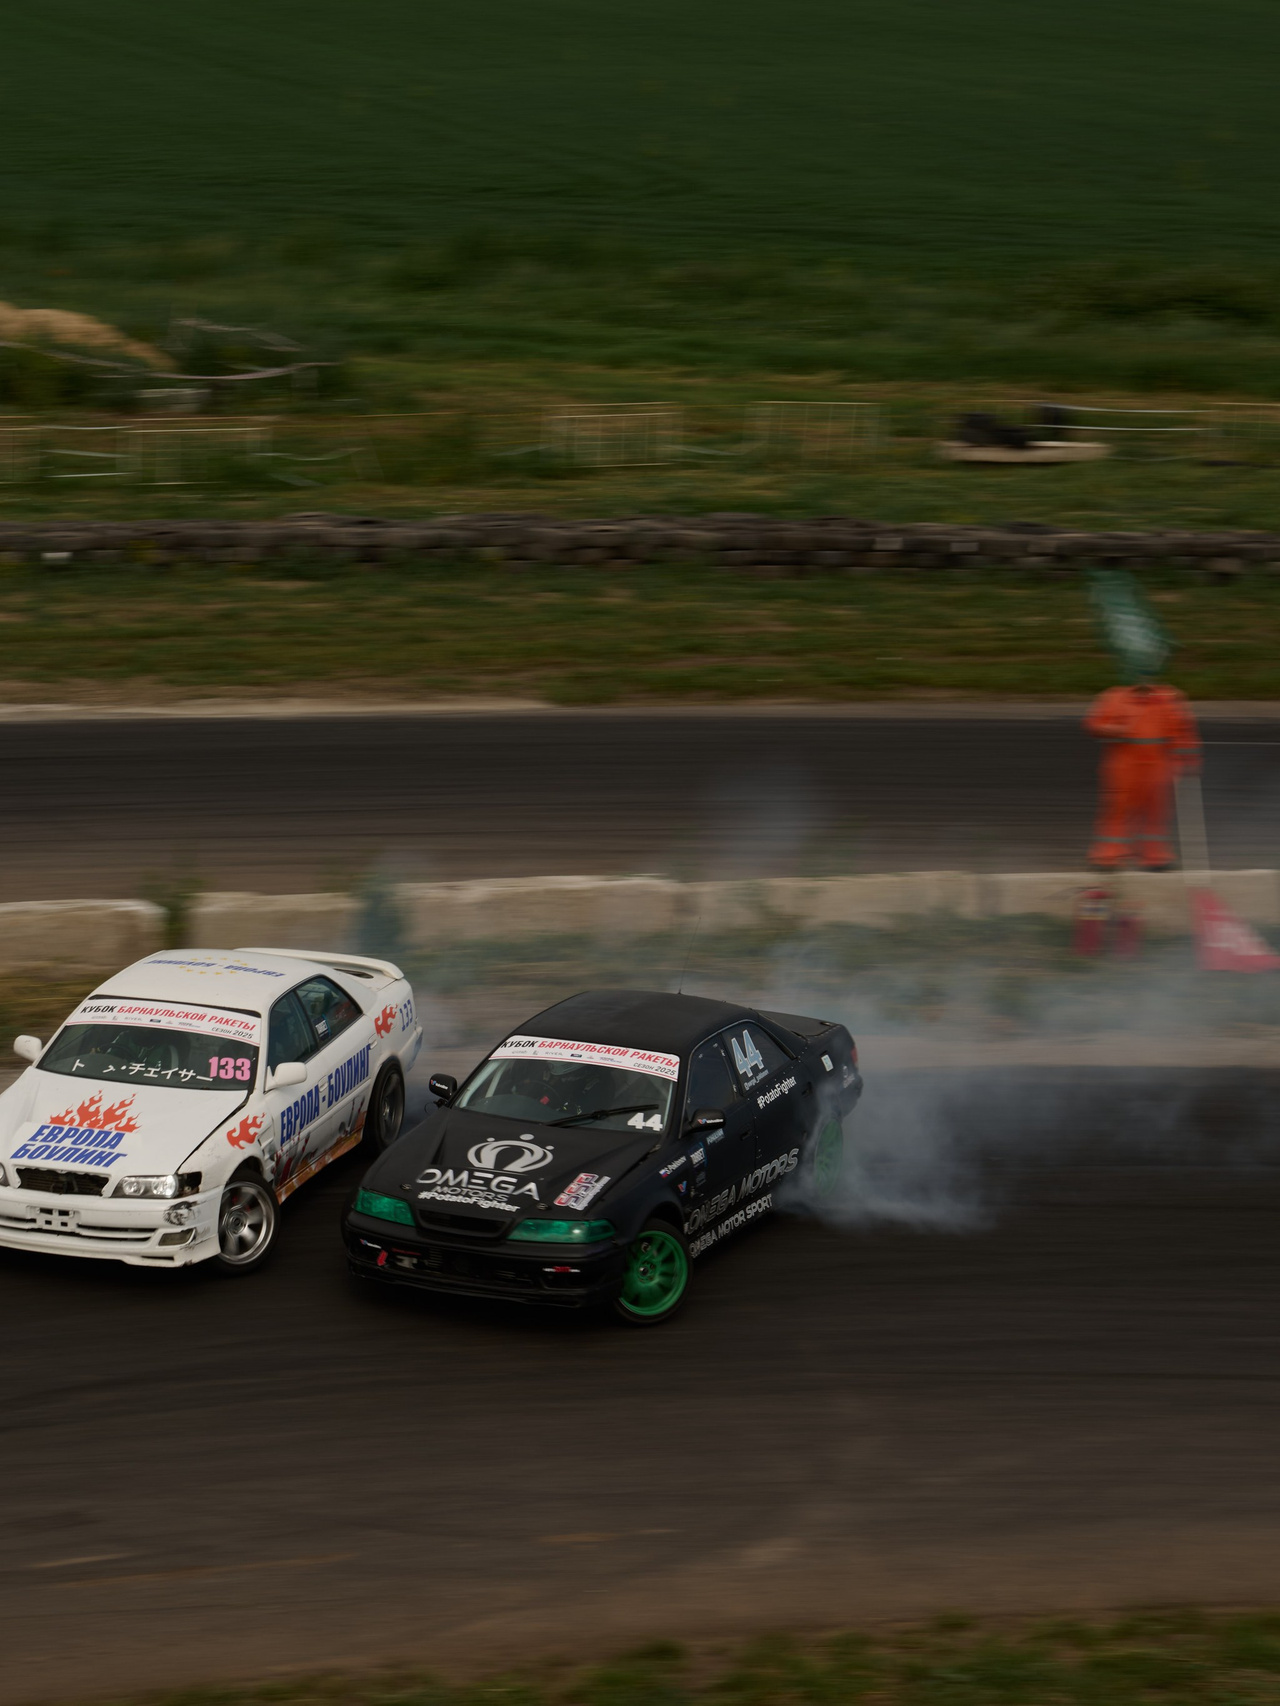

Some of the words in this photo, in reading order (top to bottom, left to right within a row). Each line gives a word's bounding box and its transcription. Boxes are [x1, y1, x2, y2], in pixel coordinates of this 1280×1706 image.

[81, 1005, 117, 1014] КУБОК
[117, 1005, 208, 1021] БАРНАУЛЬСКОЙ
[208, 1015, 256, 1031] РАКЕТЫ
[399, 999, 413, 1032] 133
[211, 1026, 232, 1035] СЕЗОН
[232, 1029, 253, 1040] 2025
[500, 1040, 538, 1048] КУБОК
[538, 1040, 629, 1057] БАРНАУЛЬСКОЙ
[629, 1051, 679, 1068] РАКЕТЫ
[731, 1029, 764, 1078] 44
[208, 1056, 250, 1081] 133
[633, 1062, 654, 1070] СЕЗОН
[655, 1066, 676, 1076] 2025
[280, 1084, 320, 1147] ЕВРОПА
[327, 1043, 372, 1109] БОУЛИНГ
[756, 1076, 797, 1110] #PotatoFighter
[627, 1112, 664, 1132] 44
[26, 1124, 126, 1150] ЕВРОПА
[10, 1143, 128, 1168] БОУЛИНГ
[415, 1168, 540, 1201] OMEGA
[431, 1185, 510, 1202] MOTORS
[687, 1185, 736, 1235] OMEGA
[736, 1148, 800, 1203] MOTORS
[417, 1191, 521, 1212] #PotatoFighter
[689, 1229, 718, 1259] OMEGA
[718, 1210, 747, 1240] MOTOR
[745, 1194, 774, 1220] SPORT
